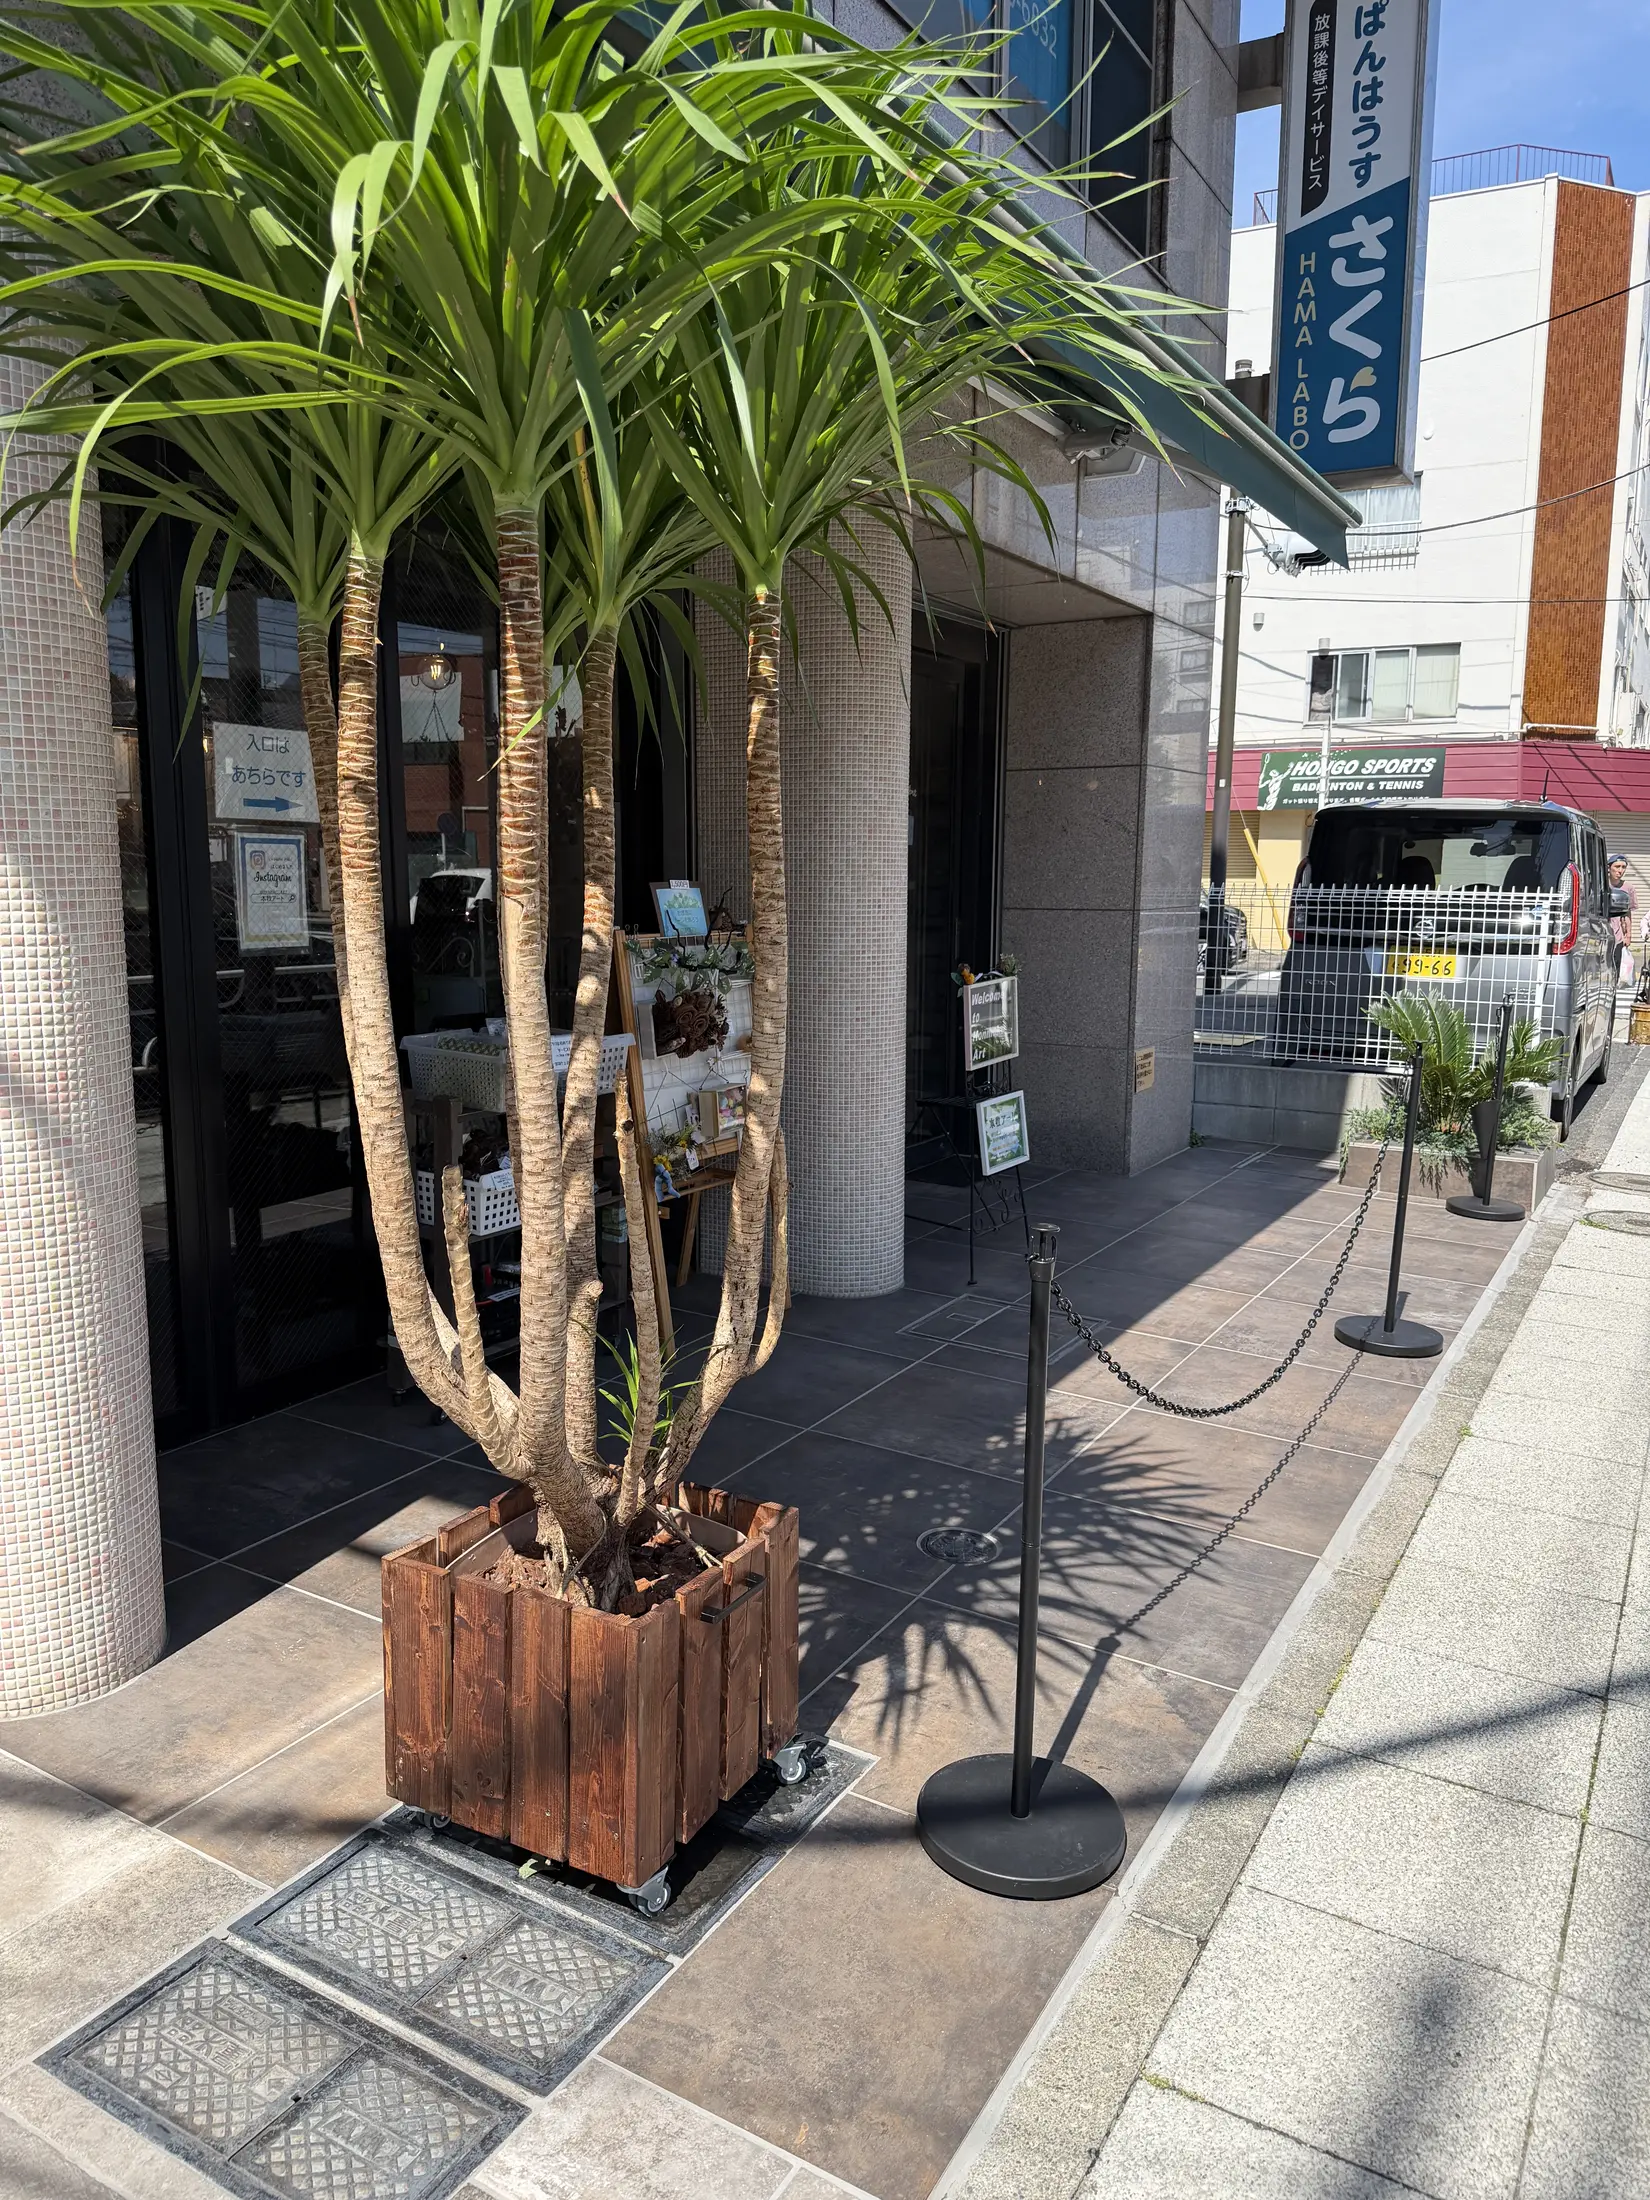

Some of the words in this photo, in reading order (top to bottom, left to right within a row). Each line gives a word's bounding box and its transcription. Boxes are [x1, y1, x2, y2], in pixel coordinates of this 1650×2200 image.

[1308, 14, 1331, 190] 放課後等デイサービス
[1348, 0, 1390, 189] ぱんはうす
[1295, 253, 1316, 347] HAMA
[1322, 214, 1394, 443] さくら
[1289, 358, 1311, 451] LABO
[246, 734, 290, 754] 入口は
[232, 765, 306, 787] あちらです
[1361, 757, 1437, 775] SPORTS
[1367, 782, 1375, 791] &
[1379, 780, 1424, 790] TENNIS
[253, 871, 292, 888] Instagram
[972, 1012, 980, 1024] to
[973, 1047, 986, 1061] Art
